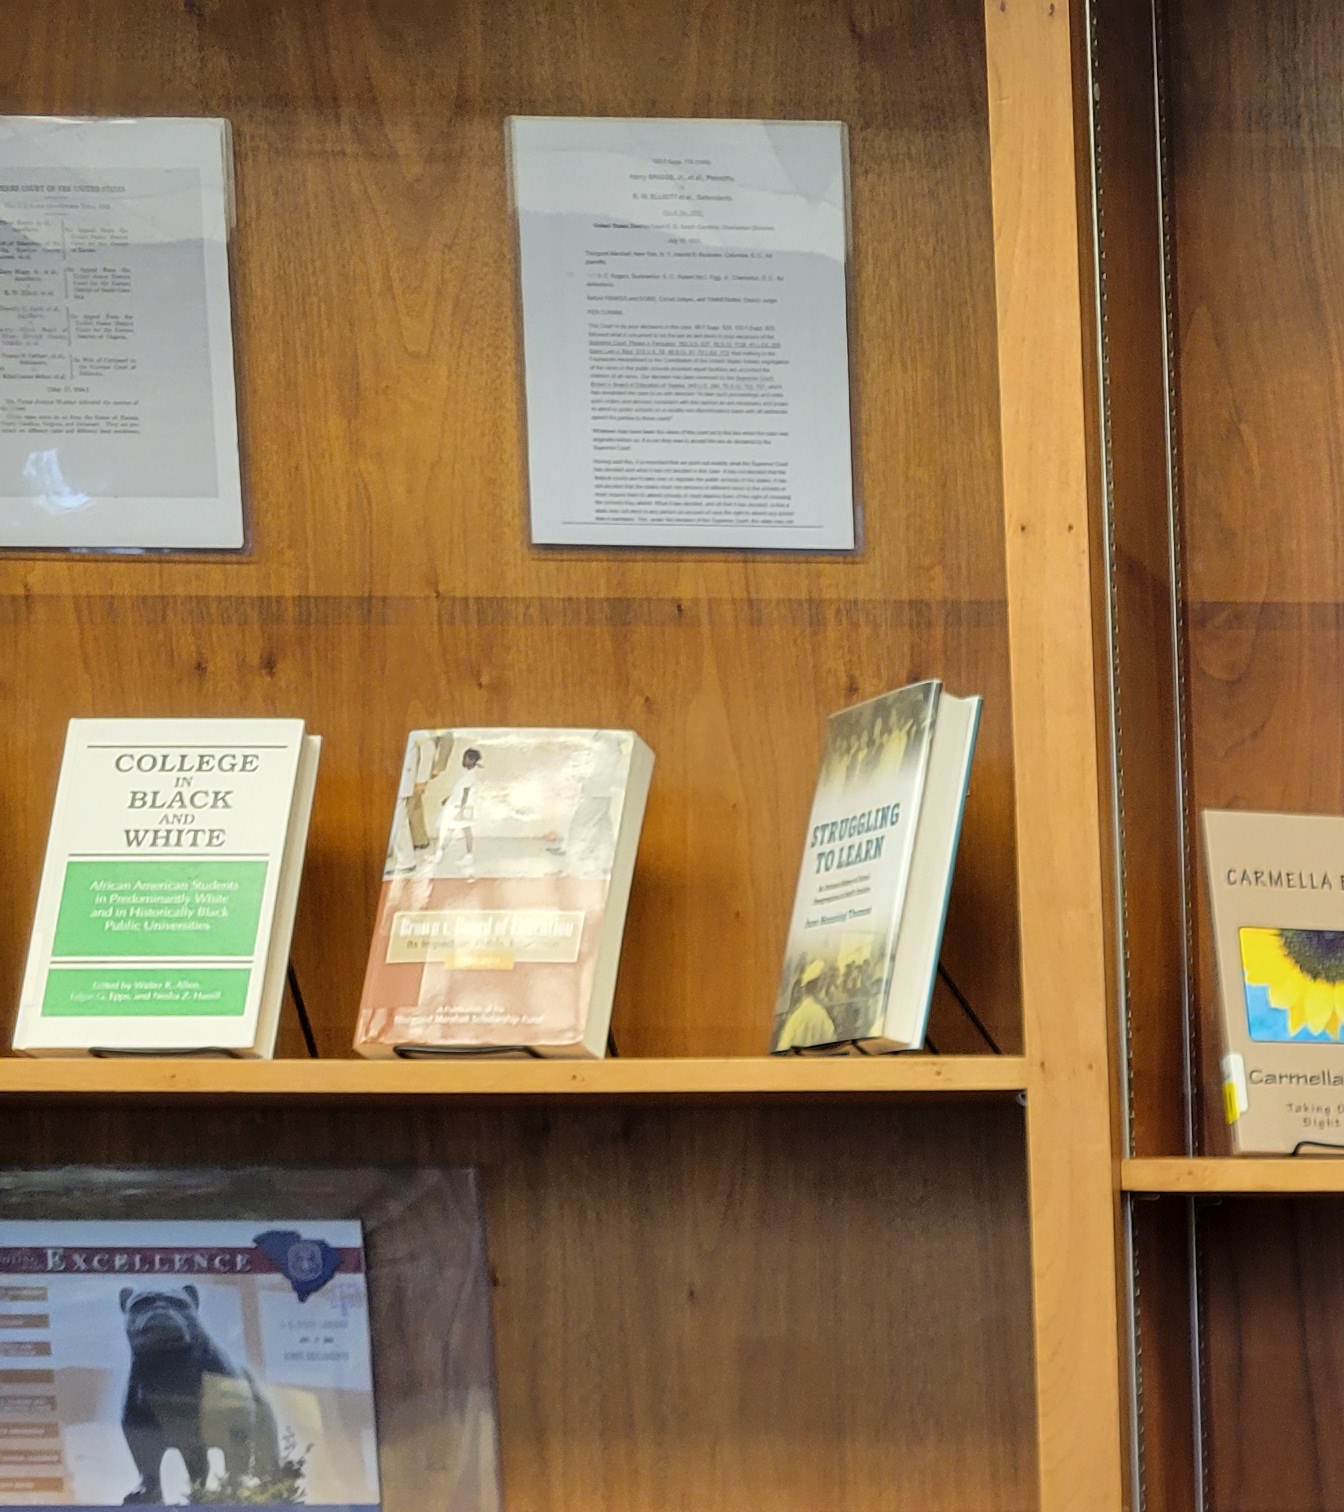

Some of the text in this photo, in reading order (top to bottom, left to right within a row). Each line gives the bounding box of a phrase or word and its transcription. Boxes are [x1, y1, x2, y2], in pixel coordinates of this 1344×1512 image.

[115, 754, 259, 772] COLLEGE
[174, 777, 193, 787] IN
[128, 791, 233, 809] BLACK
[158, 814, 195, 824] AND
[811, 802, 901, 848] STRUGGLING
[124, 829, 226, 847] WHITE
[816, 835, 885, 874] TO LEARN
[90, 880, 239, 890] African American Students
[1227, 868, 1332, 890] CARMELLA
[195, 894, 230, 904] White
[90, 908, 228, 918] and in Historically Black
[105, 921, 210, 930] Public Universities
[1287, 1103, 1331, 1117] Taking
[45, 1249, 251, 1272] EXCELLENCE
